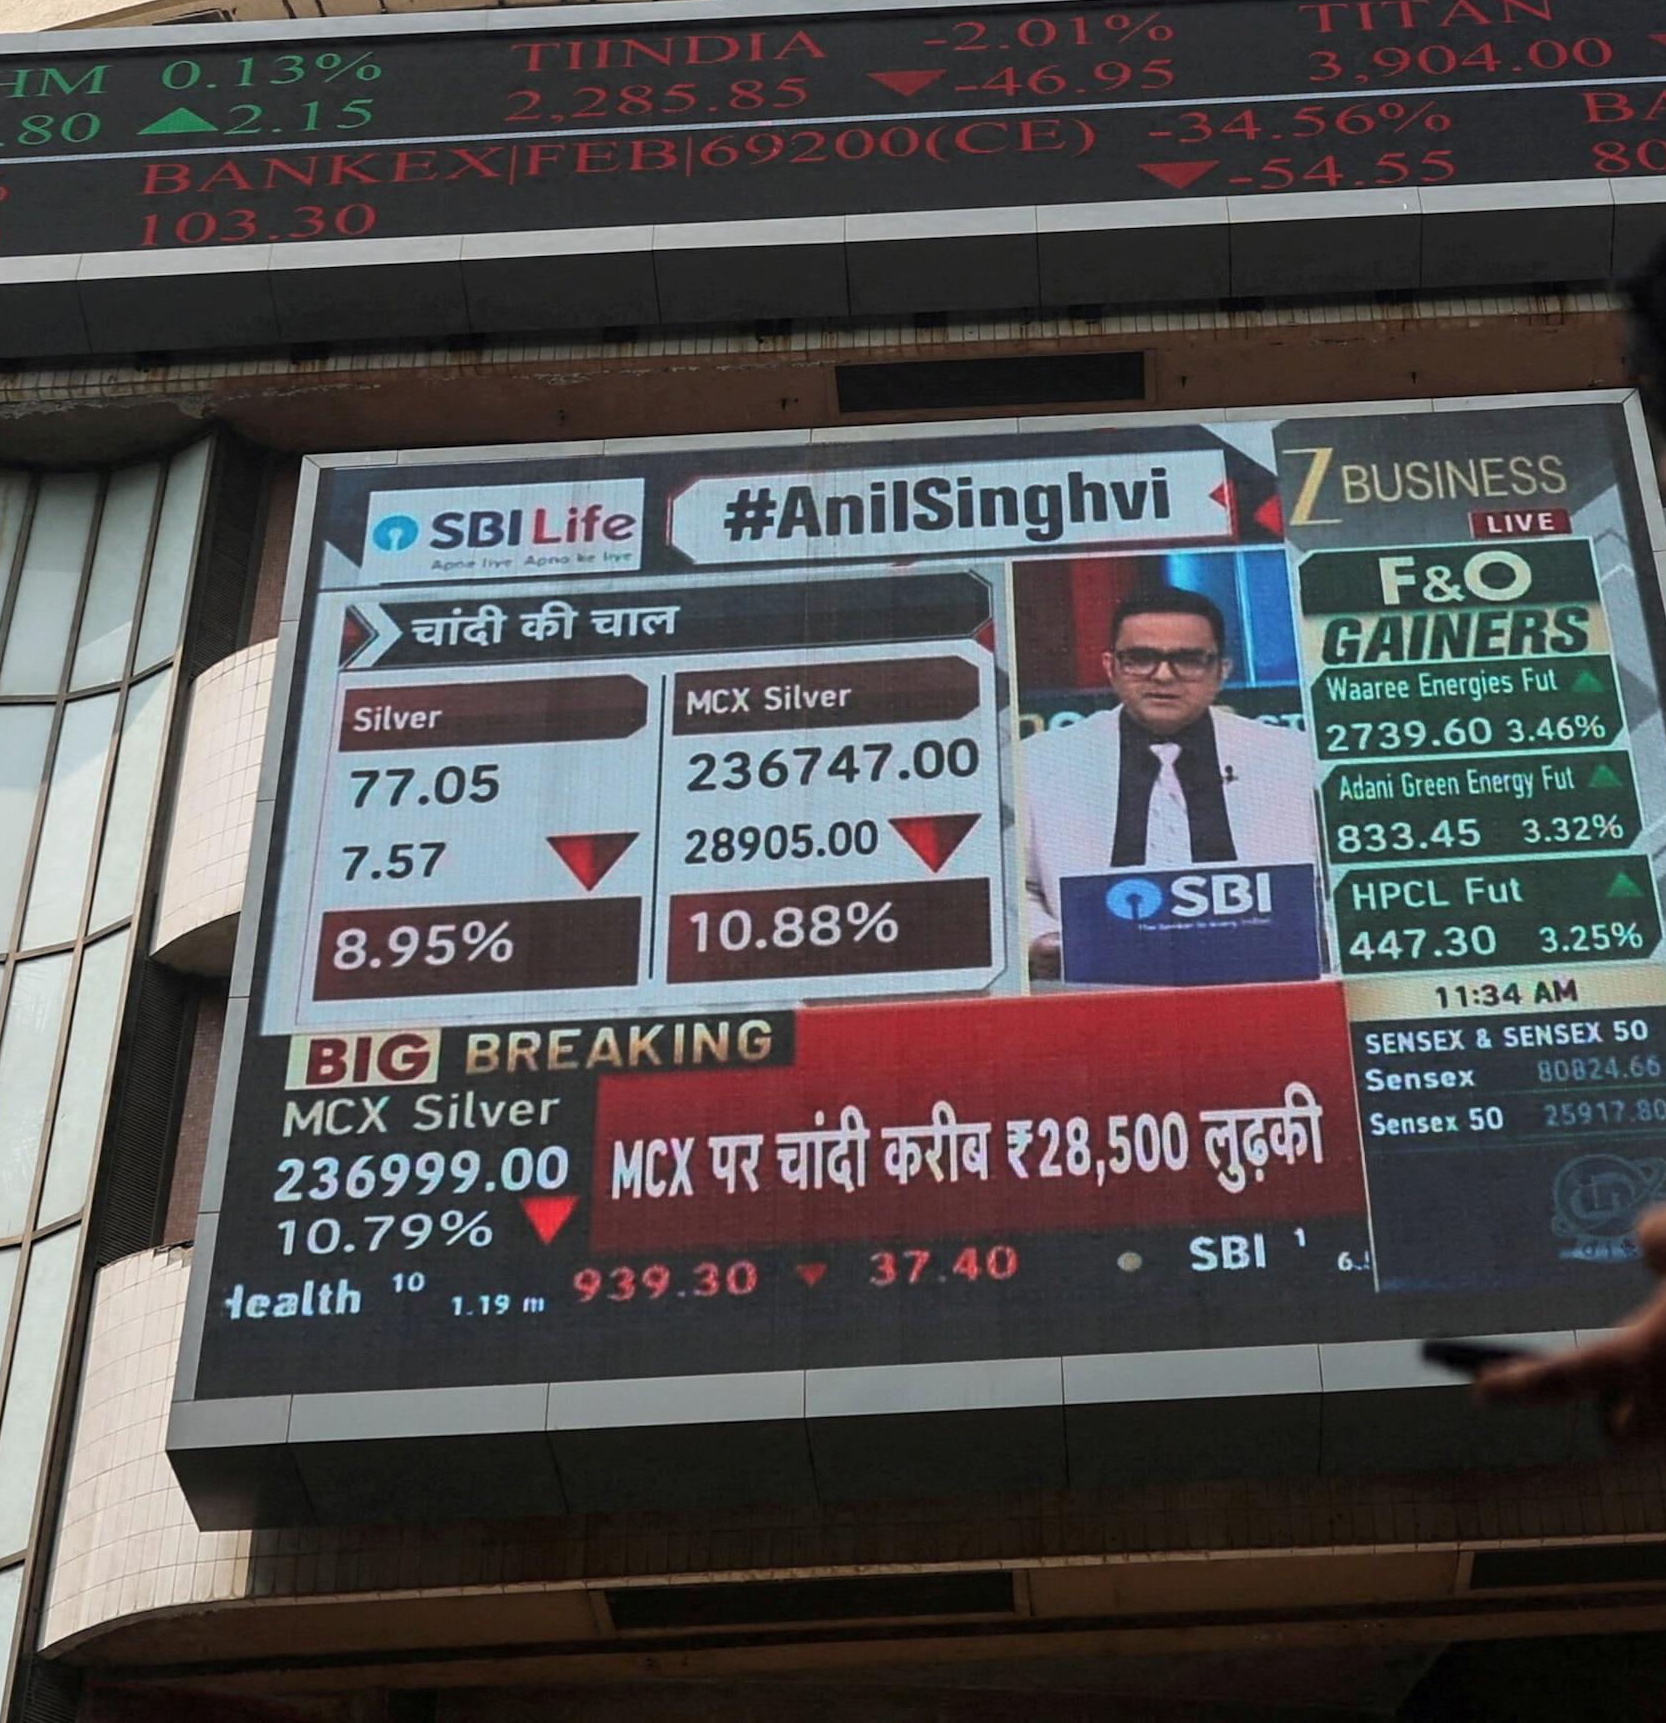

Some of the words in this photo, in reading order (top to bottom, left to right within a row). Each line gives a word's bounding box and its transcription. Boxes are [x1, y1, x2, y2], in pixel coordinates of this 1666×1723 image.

[509, 30, 827, 73] TIINDIA
[924, 14, 1176, 52] -2.01%
[1309, 38, 1614, 83] 3,904.00
[160, 53, 384, 91] 0.13%
[506, 76, 809, 123] 2,285.85
[955, 57, 1176, 97] -46.95
[225, 97, 375, 136] 2.15
[138, 117, 1097, 196] BANKEX|FEB|69200(CE)
[1147, 102, 1453, 145] -34.56%
[141, 203, 378, 247] 103.30
[1228, 148, 1456, 191] -54.55
[724, 467, 1170, 542] #AnilSinghvi
[1282, 447, 1342, 527] Z
[1340, 454, 1567, 505] BUSINESS
[430, 509, 522, 550] SBI
[532, 504, 636, 545] Life
[1487, 512, 1555, 534] LIVE
[1378, 549, 1533, 606] F&O
[410, 603, 507, 647] चांदी
[520, 600, 574, 642] की
[590, 603, 680, 636] चाल
[1321, 607, 1589, 666] GAINERS
[686, 687, 750, 717] MCX
[763, 683, 852, 712] Silver
[1326, 676, 1409, 702] Waaree
[1418, 671, 1514, 702] Energies
[1521, 667, 1558, 692] Fut
[352, 704, 442, 734] Silver
[1325, 716, 1492, 753] 2739.60
[1506, 714, 1606, 744] 3.46%
[350, 764, 500, 809] 77.05
[687, 737, 980, 792] 236747.00
[1339, 774, 1394, 801] Adani
[1402, 771, 1460, 797] Green
[1467, 769, 1534, 798] Energy
[1541, 766, 1575, 790] Fut
[684, 820, 879, 865] 28905.00
[1337, 818, 1482, 854] 833.45
[1521, 813, 1624, 844] 3.32%
[342, 841, 447, 881] 7.57
[1171, 872, 1272, 917] SBI
[1351, 880, 1450, 911] HPCL
[1465, 876, 1524, 905] Fut
[332, 921, 515, 972] 8.95%
[689, 901, 899, 953] 10.88%
[1348, 925, 1497, 962] 447.30
[1538, 921, 1644, 953] 3.25%
[1435, 982, 1523, 1009] 11:34
[1533, 979, 1579, 1003] AM
[304, 1031, 432, 1087] BIG
[464, 1019, 774, 1075] BREAKING
[1365, 1028, 1465, 1055] SENSEX
[1476, 1027, 1492, 1049] &
[1503, 1021, 1605, 1048] SENSEX
[1613, 1020, 1649, 1043] 50
[1365, 1068, 1477, 1093] Sensex
[1537, 1056, 1662, 1083] 80824.66
[282, 1095, 388, 1139] MCX
[412, 1091, 560, 1133] Silver
[1369, 1111, 1460, 1137] Sensex
[1468, 1106, 1504, 1132] 50
[611, 1137, 694, 1200] MCX
[709, 1133, 763, 1194] पर
[776, 1103, 870, 1194] चांदी
[881, 1100, 991, 1185] करीब
[1006, 1112, 1189, 1186] ₹28,500
[273, 1144, 570, 1203] 236999.00
[276, 1208, 494, 1256] 10.79%
[393, 1272, 426, 1293] 10
[452, 1294, 510, 1316] 1.19
[573, 1260, 758, 1303] 939.30
[868, 1244, 1019, 1286] 37.40
[1189, 1233, 1266, 1272] SBI
[1293, 1227, 1306, 1247] 1
